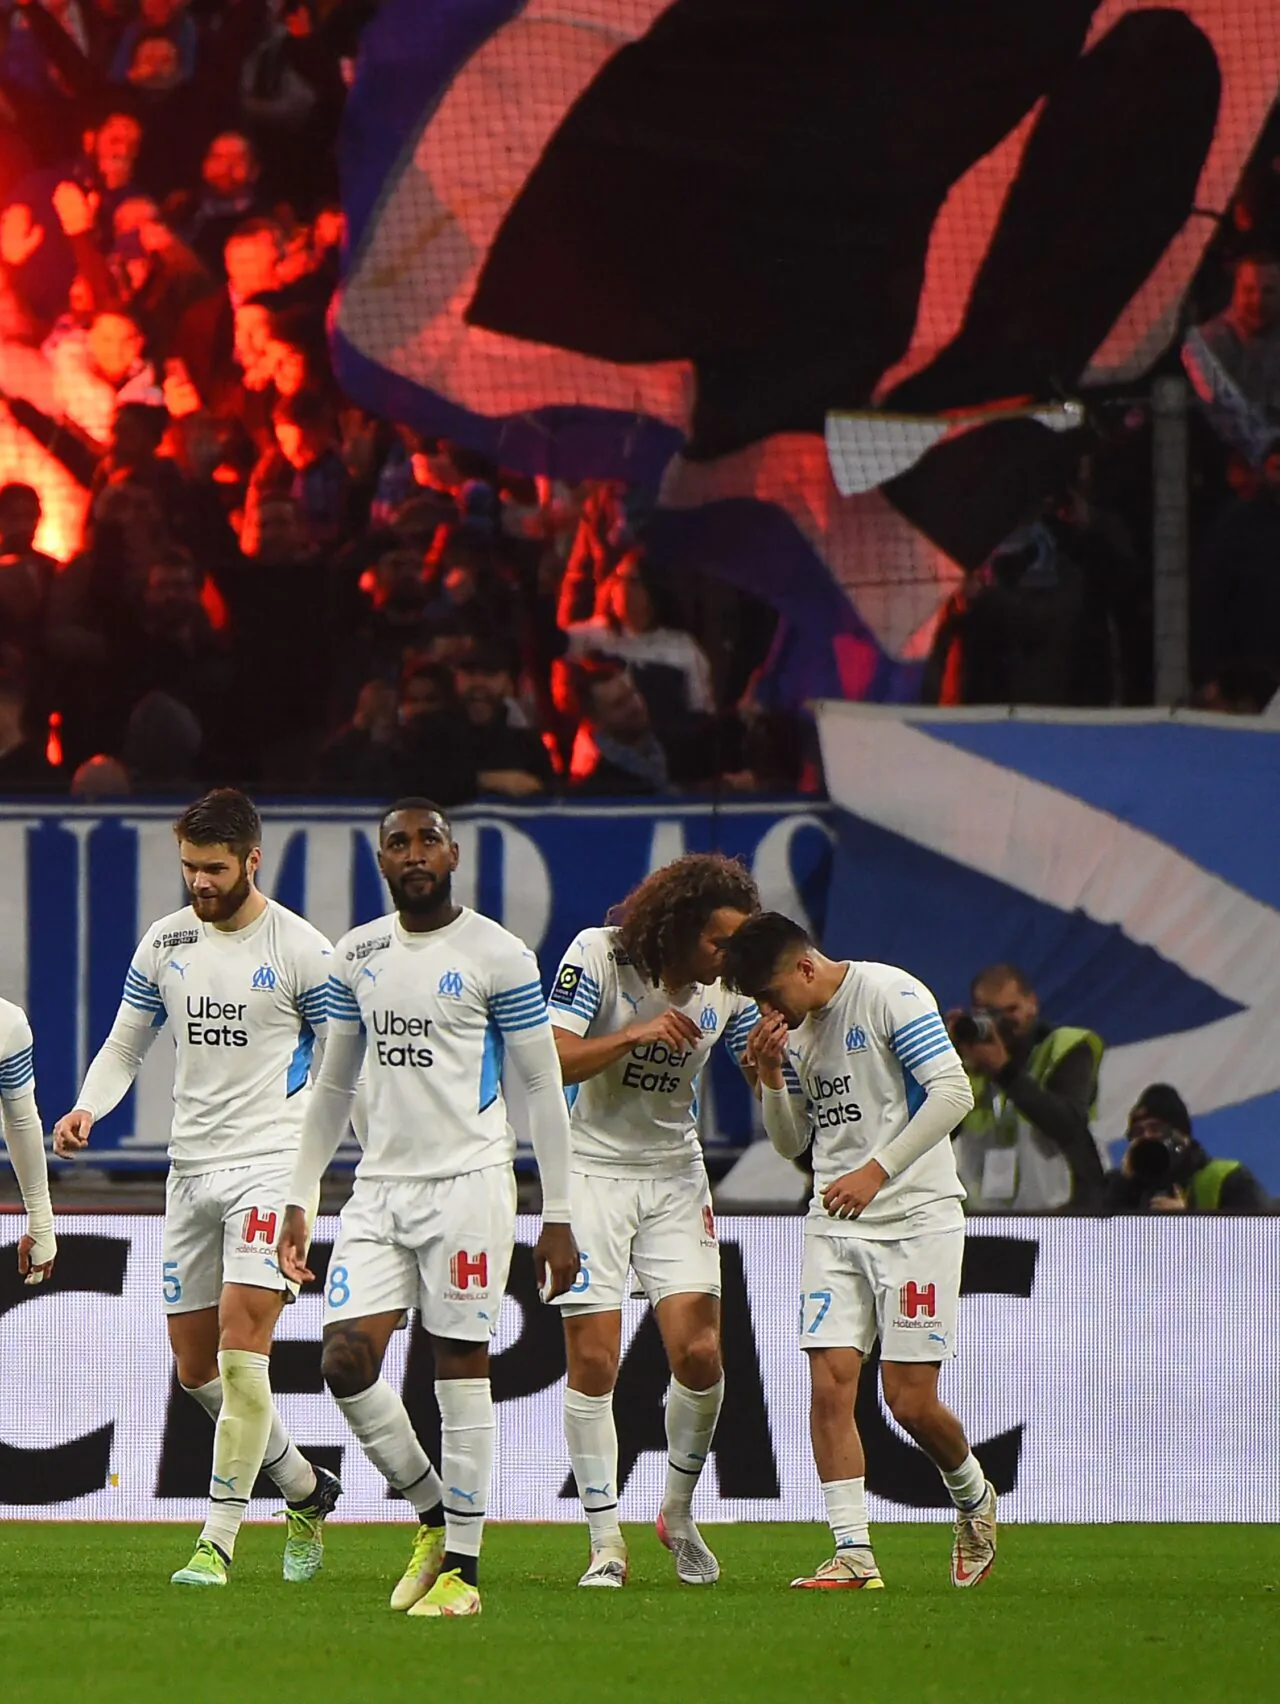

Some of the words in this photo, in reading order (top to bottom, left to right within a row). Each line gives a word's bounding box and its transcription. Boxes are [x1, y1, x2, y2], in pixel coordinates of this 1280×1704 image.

[186, 995, 247, 1021] Uber
[187, 1022, 248, 1047] Eats
[372, 1010, 433, 1037] Uber
[376, 1041, 434, 1067] Eats
[622, 1062, 680, 1093] Eats
[806, 1074, 852, 1101] Uber
[817, 1101, 862, 1129] Eats
[163, 1262, 182, 1303] 5
[328, 1266, 350, 1308] 8
[443, 1290, 489, 1301] Hotels.co
[892, 1319, 943, 1329] Hotels.com
